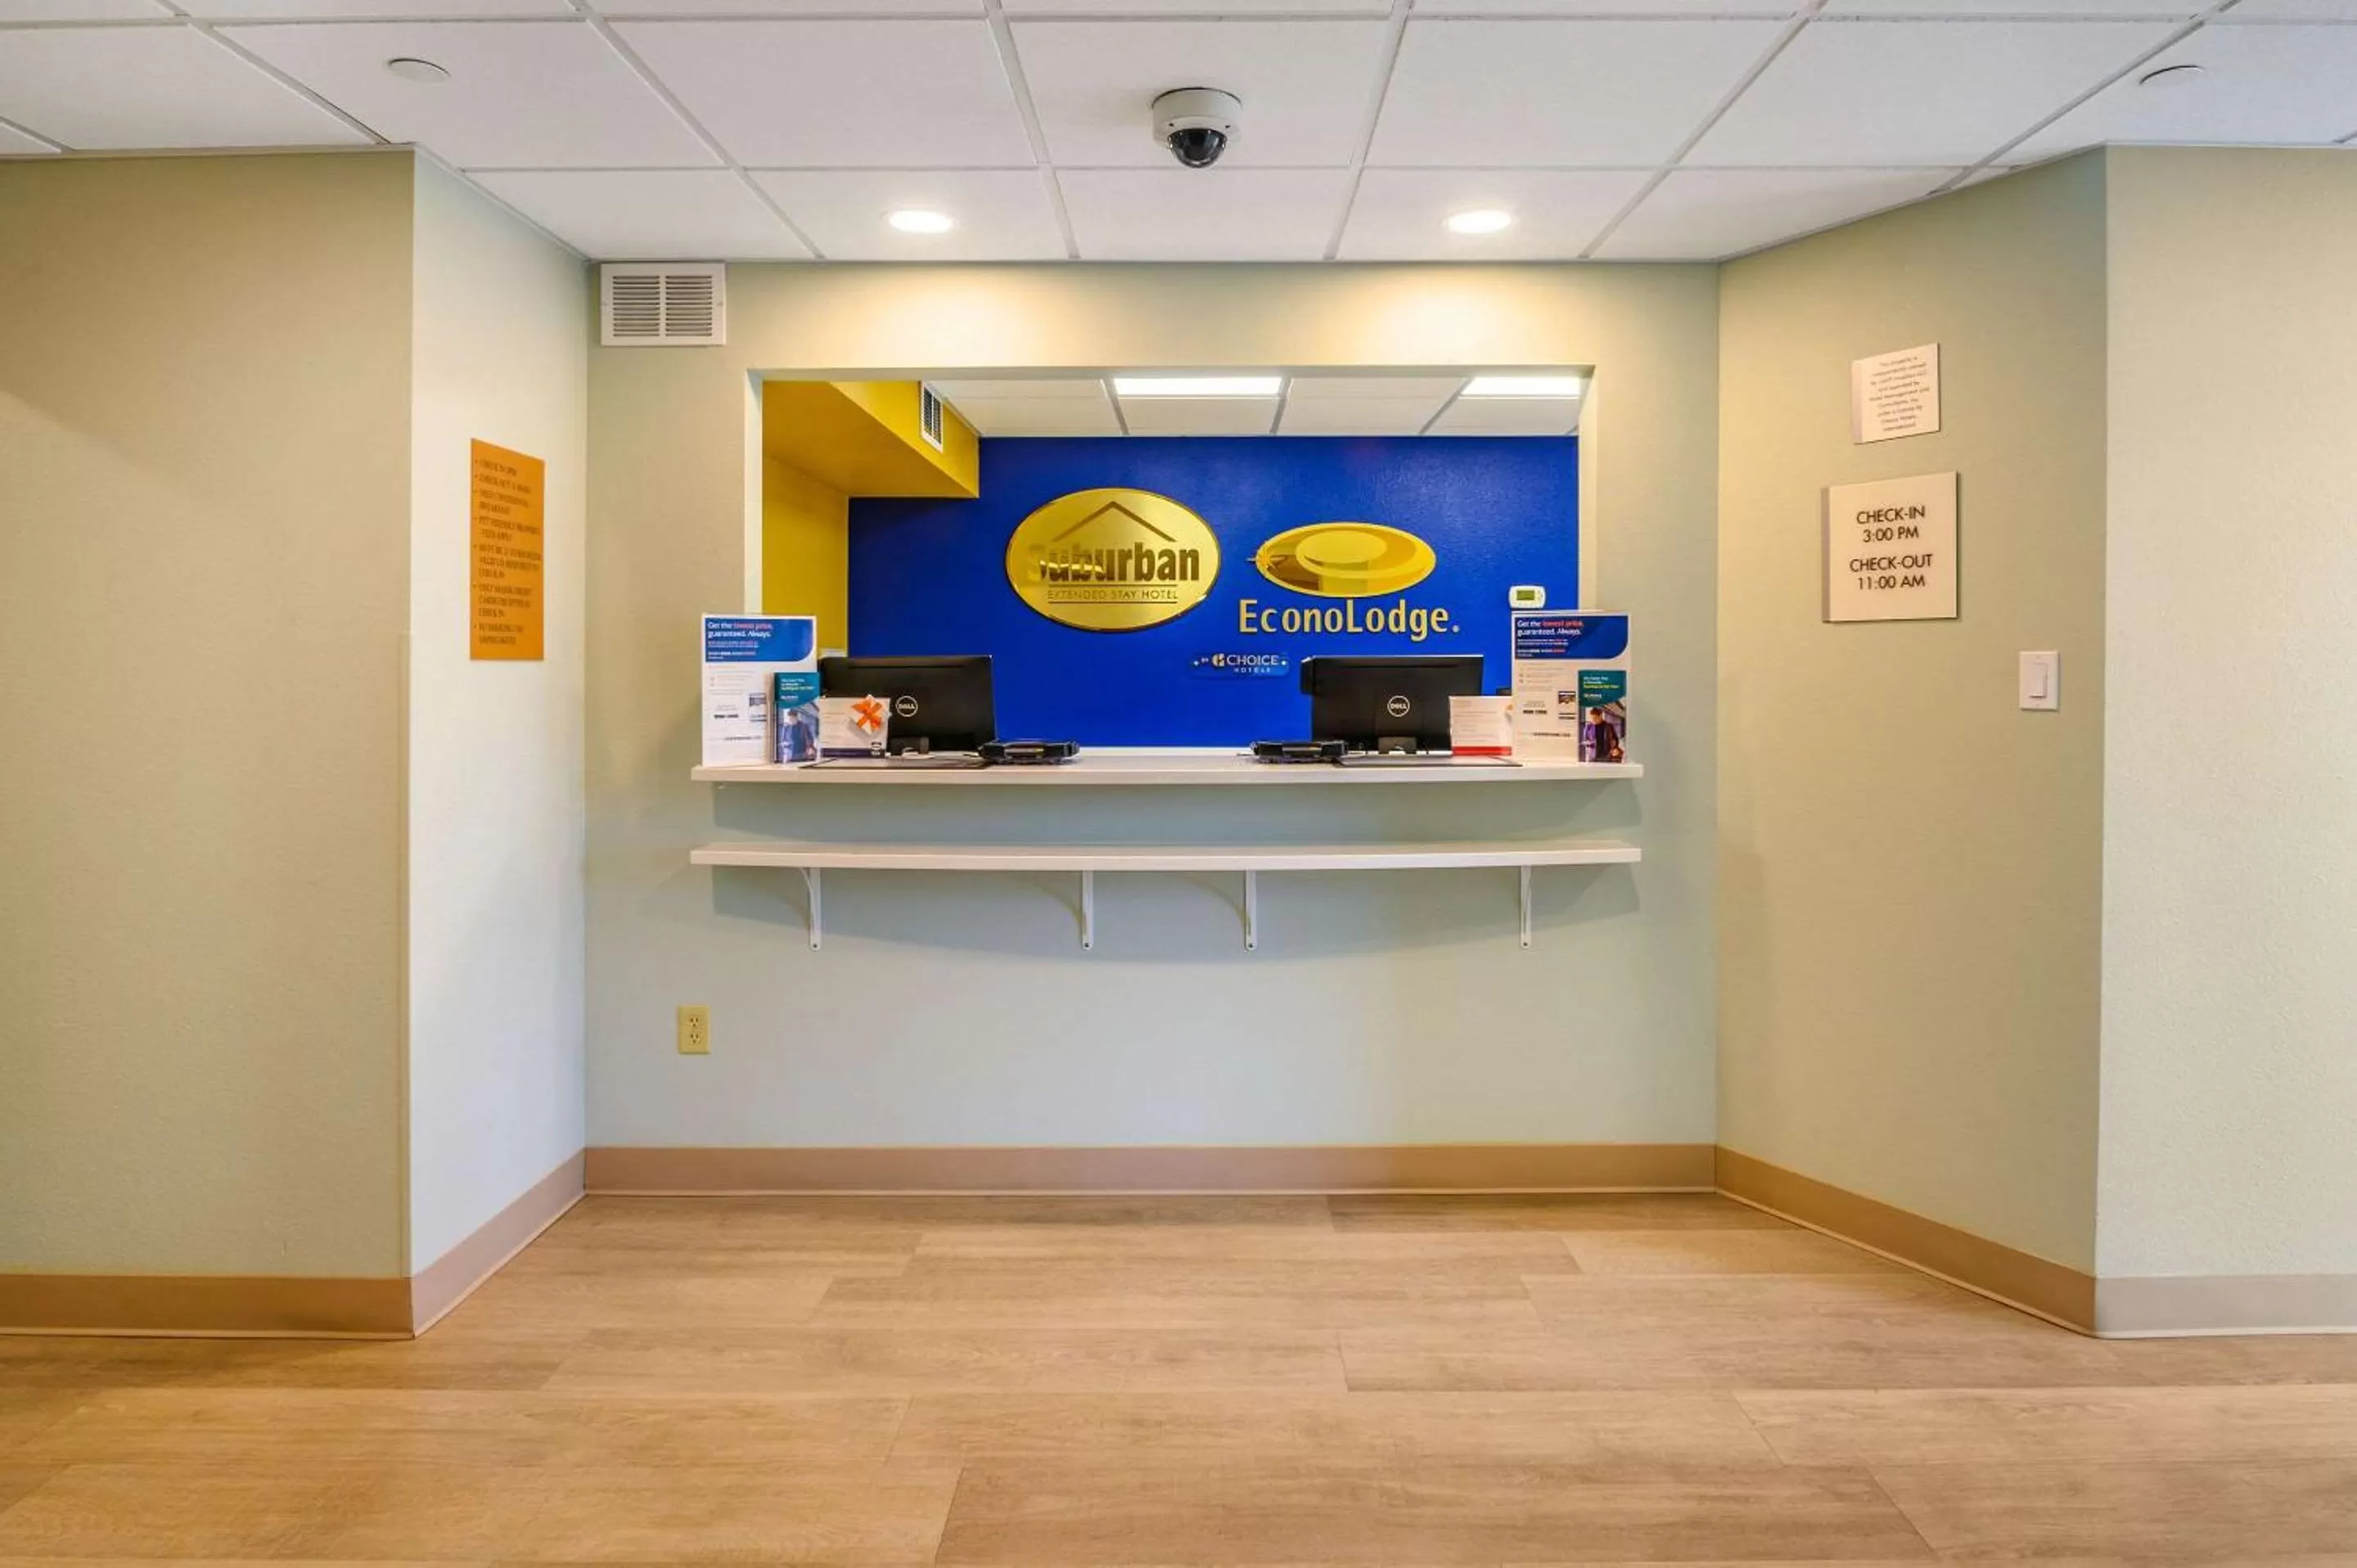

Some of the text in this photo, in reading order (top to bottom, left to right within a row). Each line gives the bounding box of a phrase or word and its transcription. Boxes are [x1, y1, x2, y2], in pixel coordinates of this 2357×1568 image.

[1856, 505, 1926, 525] CHECK-IN
[1863, 525, 1919, 543] 3:00 PM
[1029, 542, 1200, 582] Suburban
[1850, 554, 1933, 572] CHECK-OUT
[1858, 574, 1926, 590] 11:00 AM
[1048, 588, 1178, 600] EXTENDED STAY HOTEL
[1227, 655, 1279, 665] CHOICE
